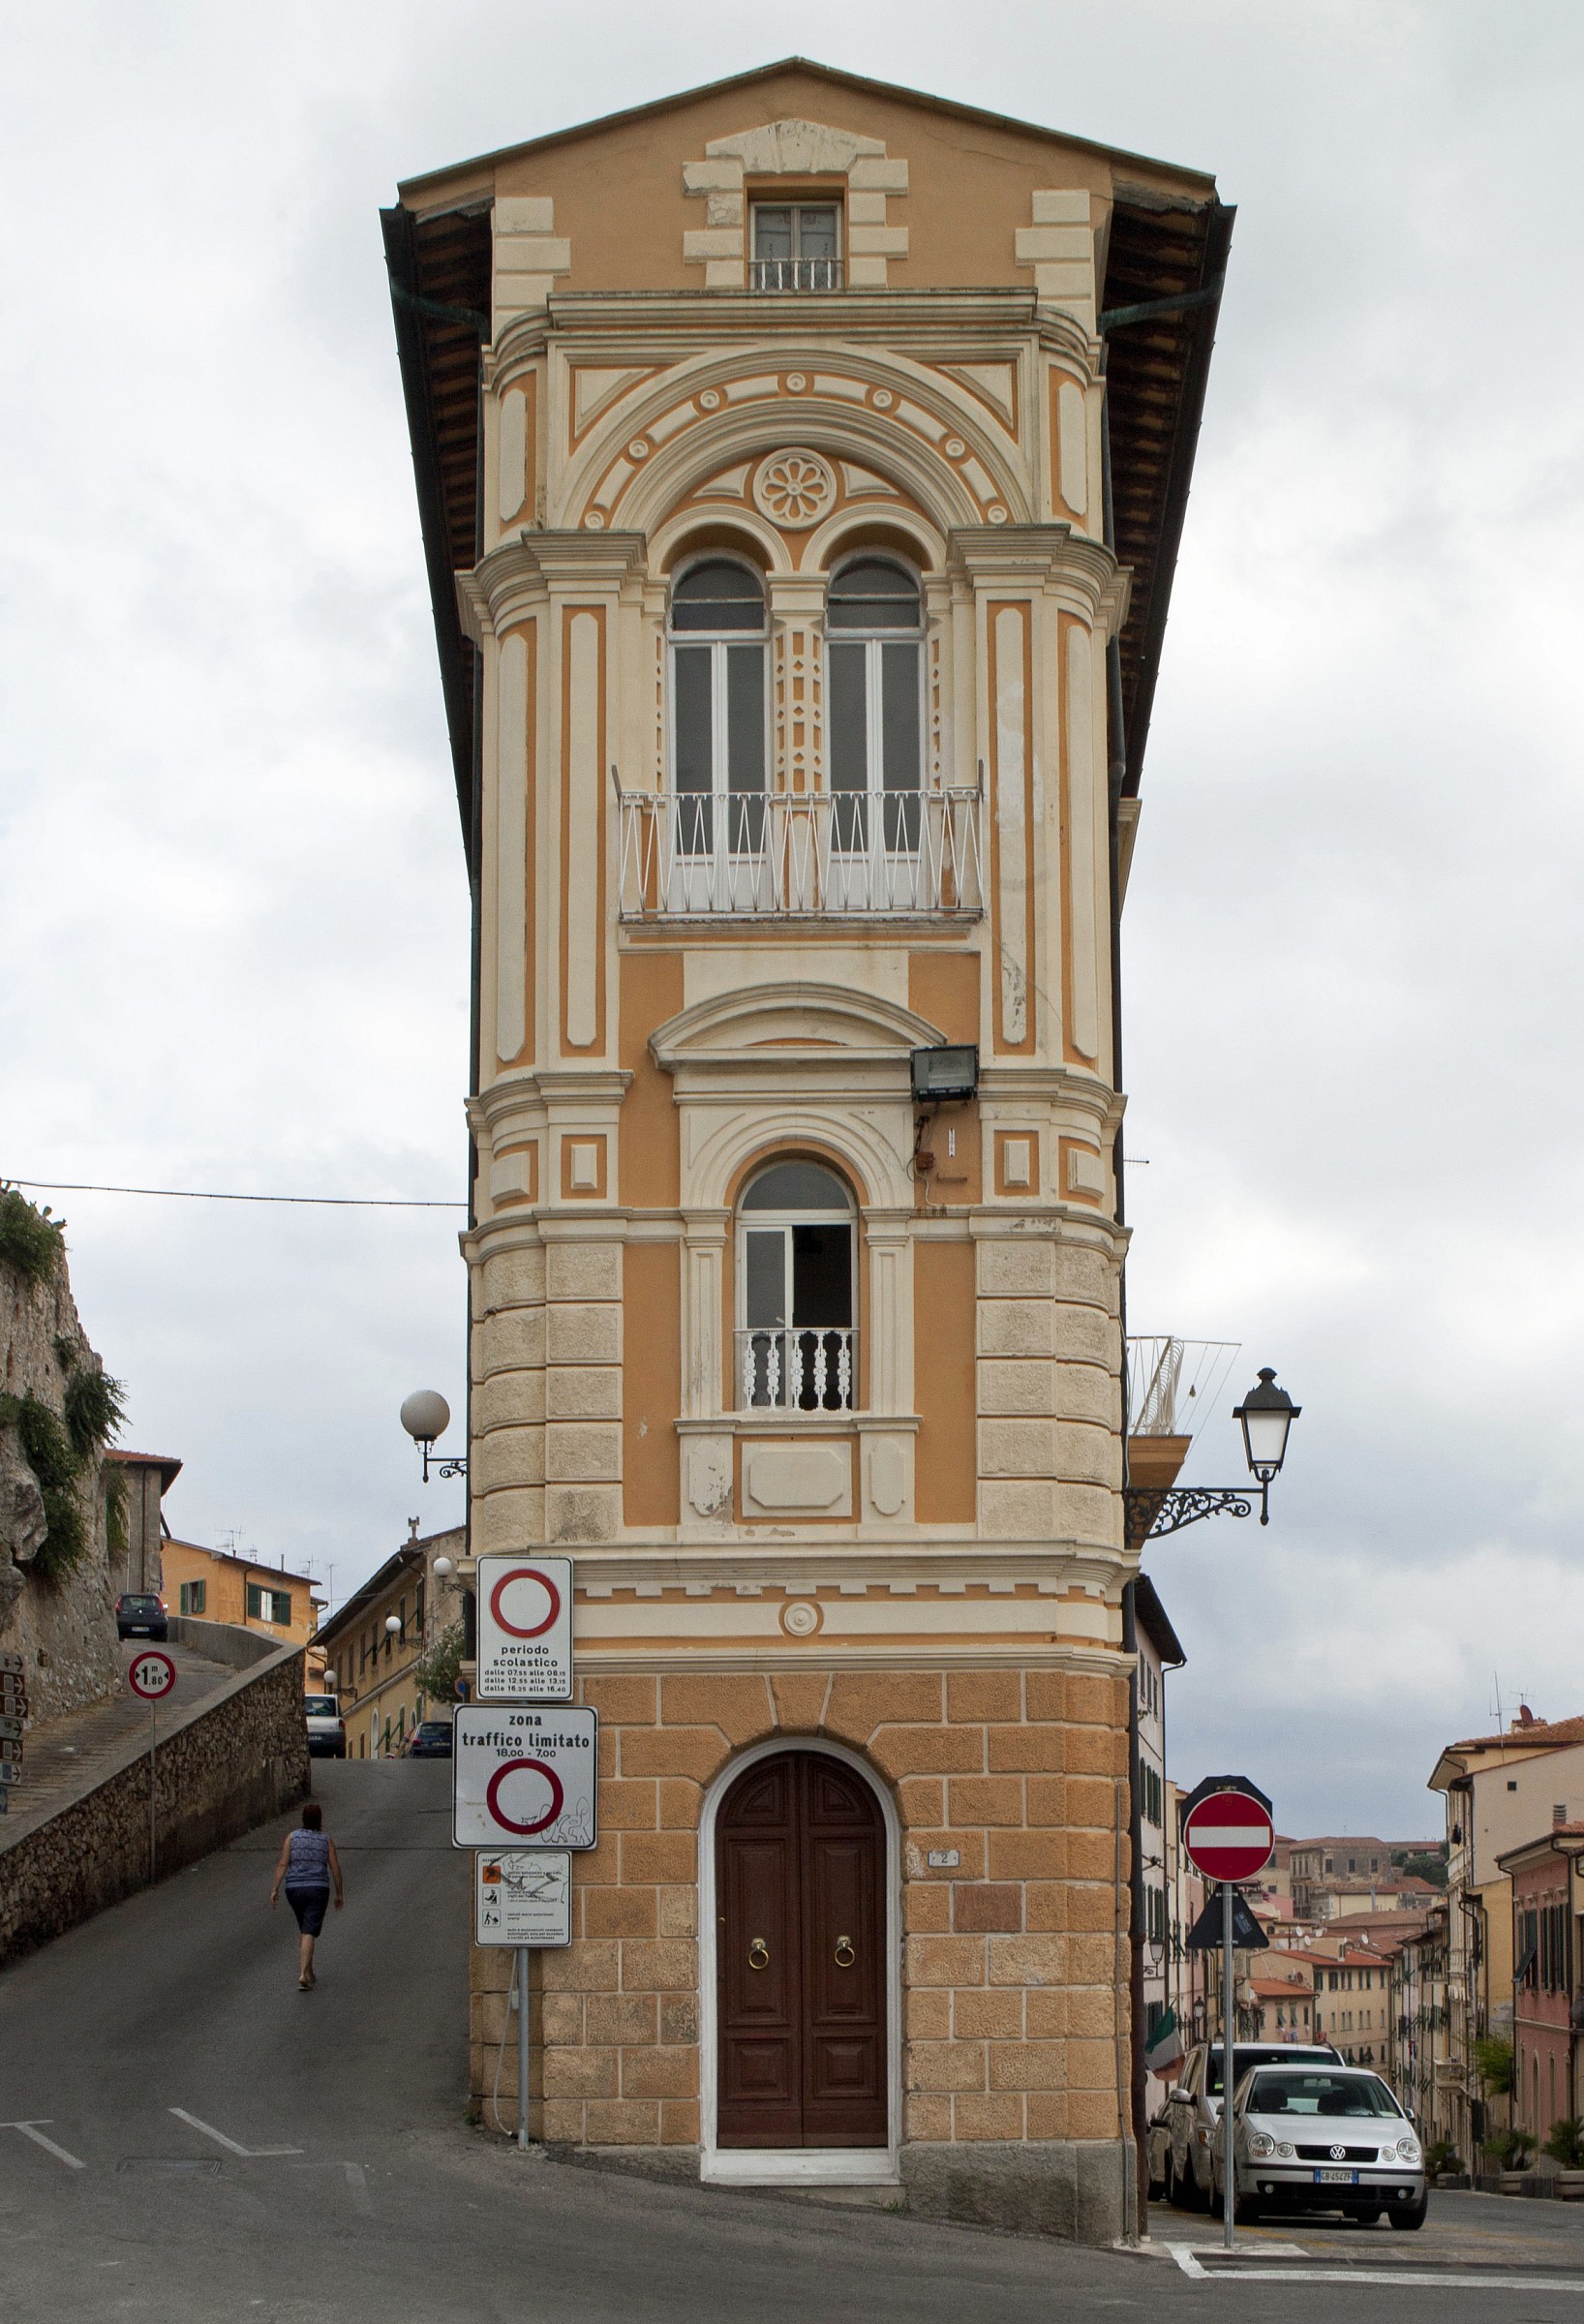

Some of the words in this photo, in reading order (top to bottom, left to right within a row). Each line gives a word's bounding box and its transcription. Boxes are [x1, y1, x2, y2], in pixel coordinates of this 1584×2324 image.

[502, 1644, 549, 1655] periodo
[493, 1658, 558, 1667] scolastico
[508, 1715, 542, 1726] zona
[462, 1731, 522, 1747] traffico
[529, 1732, 590, 1748] limitato
[941, 1852, 948, 1864] 2
